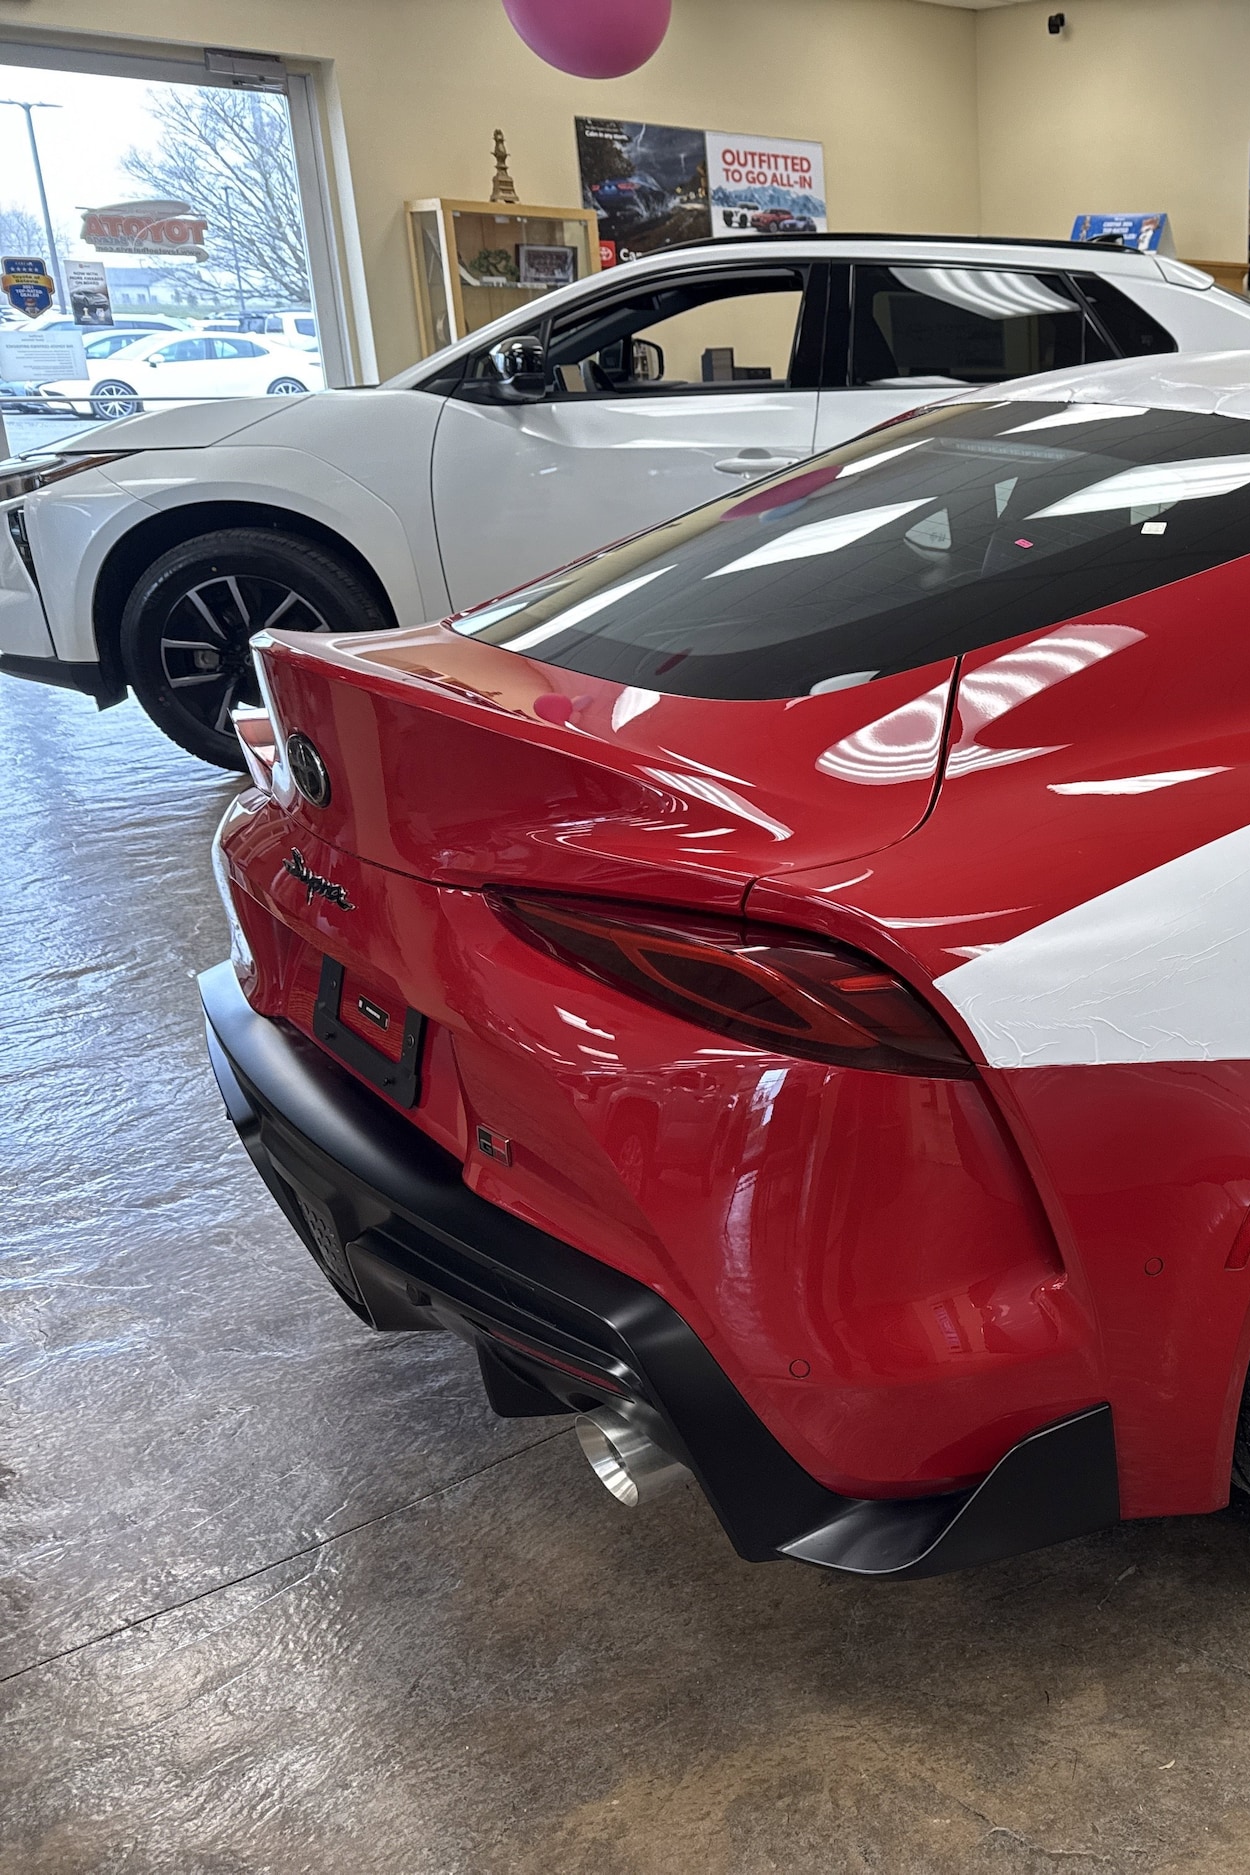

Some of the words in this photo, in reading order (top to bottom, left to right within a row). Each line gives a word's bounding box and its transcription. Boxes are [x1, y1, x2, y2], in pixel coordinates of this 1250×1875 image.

[721, 149, 811, 173] OUTFITTED
[723, 168, 742, 183] TO
[745, 171, 767, 185] GO
[770, 173, 812, 190] ALL-IN
[282, 847, 356, 912] Supra
